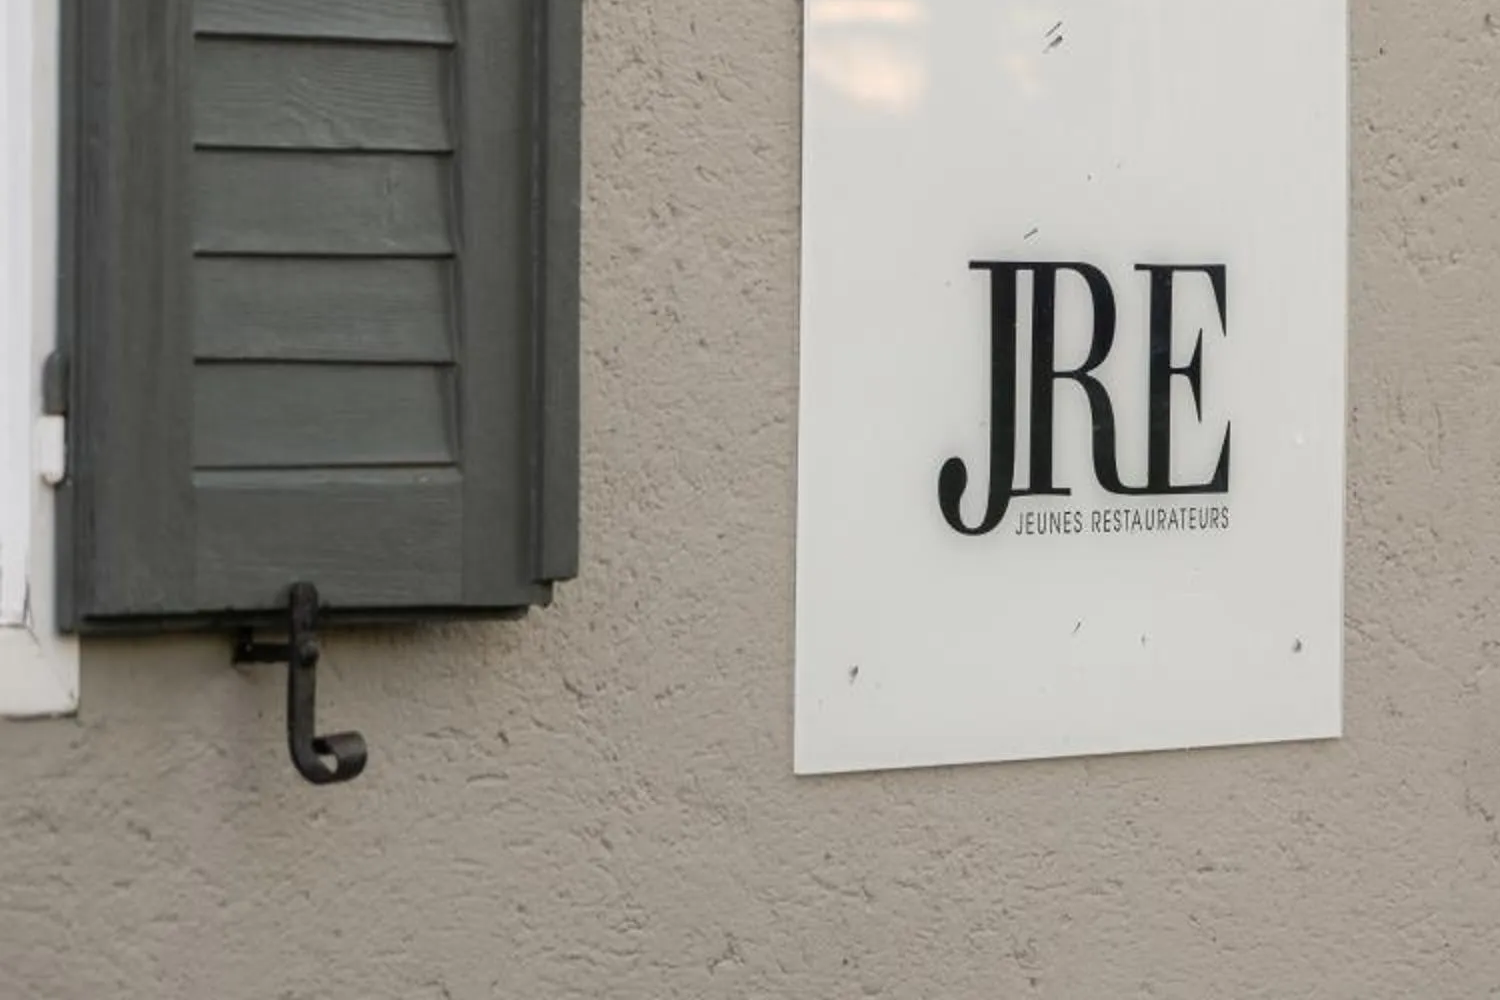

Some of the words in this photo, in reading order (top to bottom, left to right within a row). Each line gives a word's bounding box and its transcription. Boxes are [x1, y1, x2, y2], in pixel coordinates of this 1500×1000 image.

[938, 260, 1231, 536] JRE
[1015, 510, 1083, 535] JEUNES
[1091, 507, 1230, 533] RESTAURATEURS
